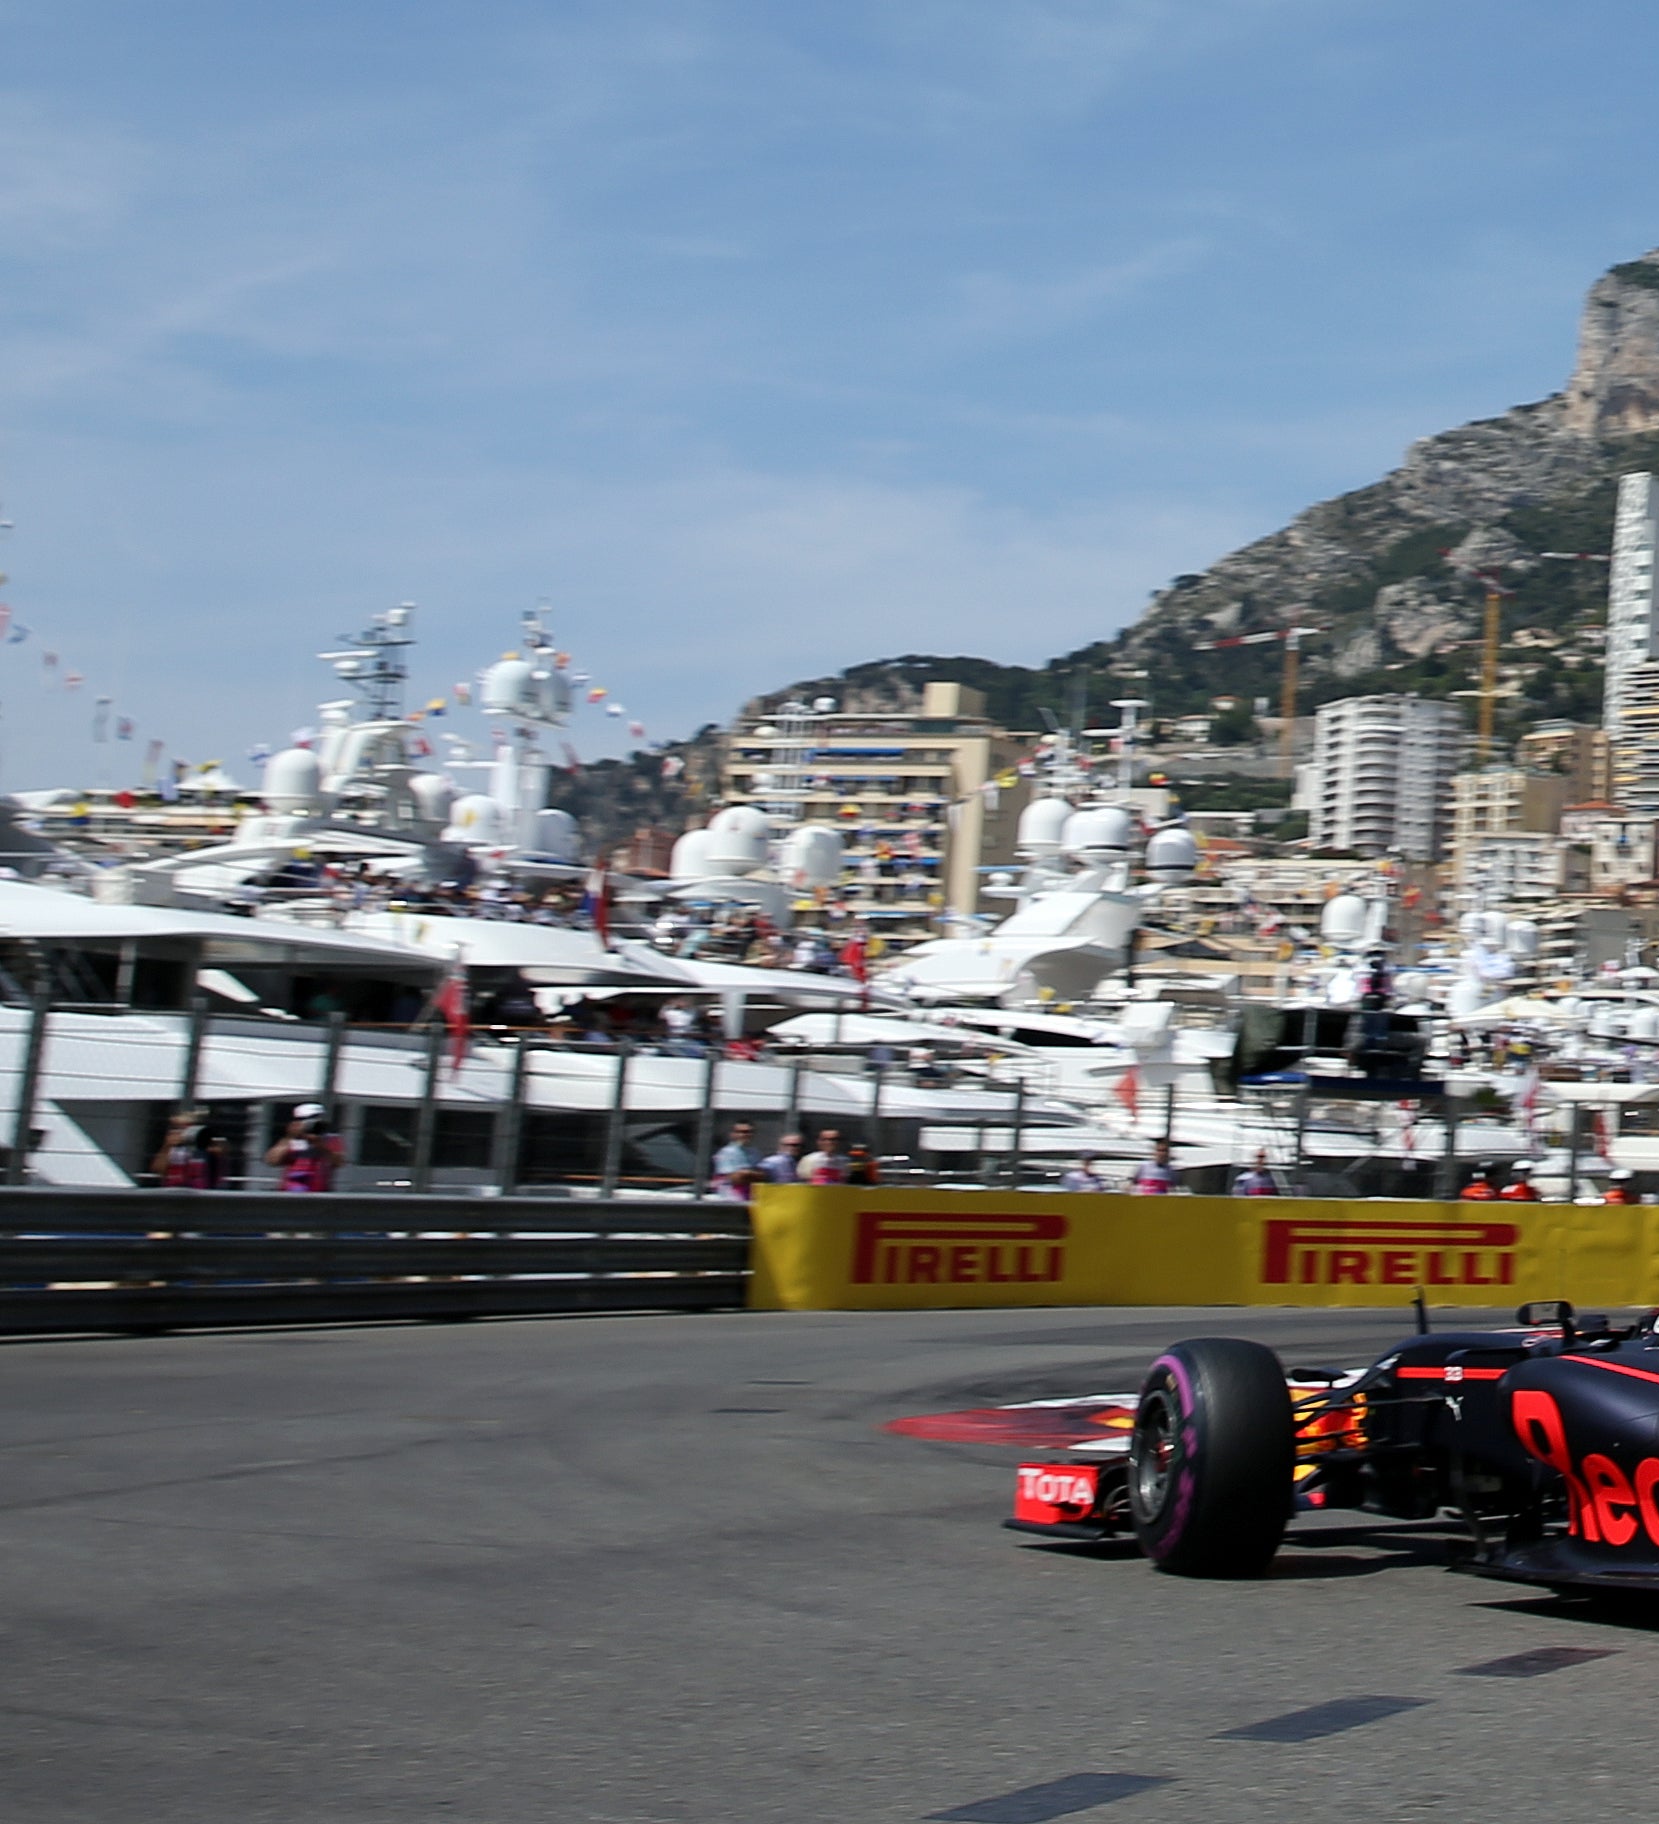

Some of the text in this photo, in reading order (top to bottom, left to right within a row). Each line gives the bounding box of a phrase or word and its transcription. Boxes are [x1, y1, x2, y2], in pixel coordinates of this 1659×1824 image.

[851, 1212, 1070, 1285] PIRELLI
[1259, 1220, 1520, 1286] PIRELLI
[1018, 1468, 1095, 1505] TOTA
